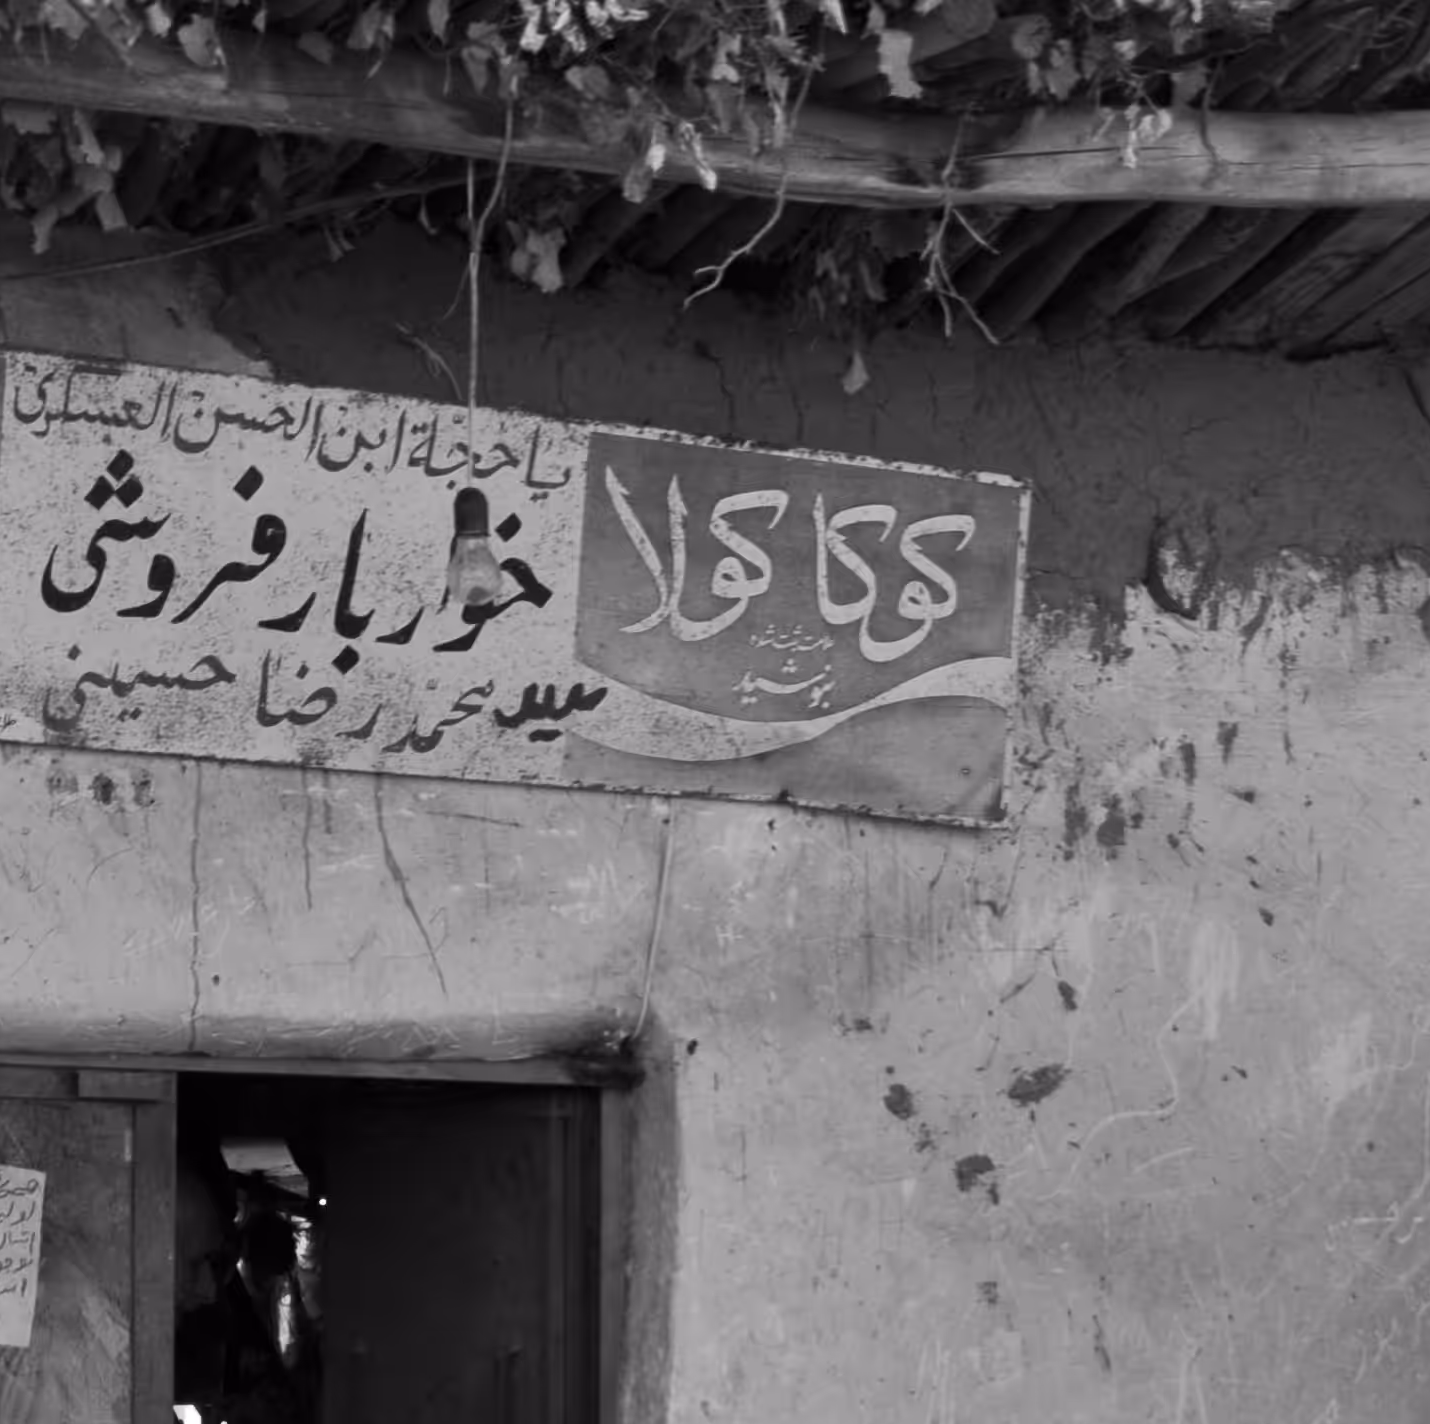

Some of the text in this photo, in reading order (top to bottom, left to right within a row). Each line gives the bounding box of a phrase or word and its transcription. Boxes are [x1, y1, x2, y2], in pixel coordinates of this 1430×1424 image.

[173, 396, 324, 464] الحسن
[40, 449, 288, 625] فروشی
[42, 644, 237, 733] حسینی
